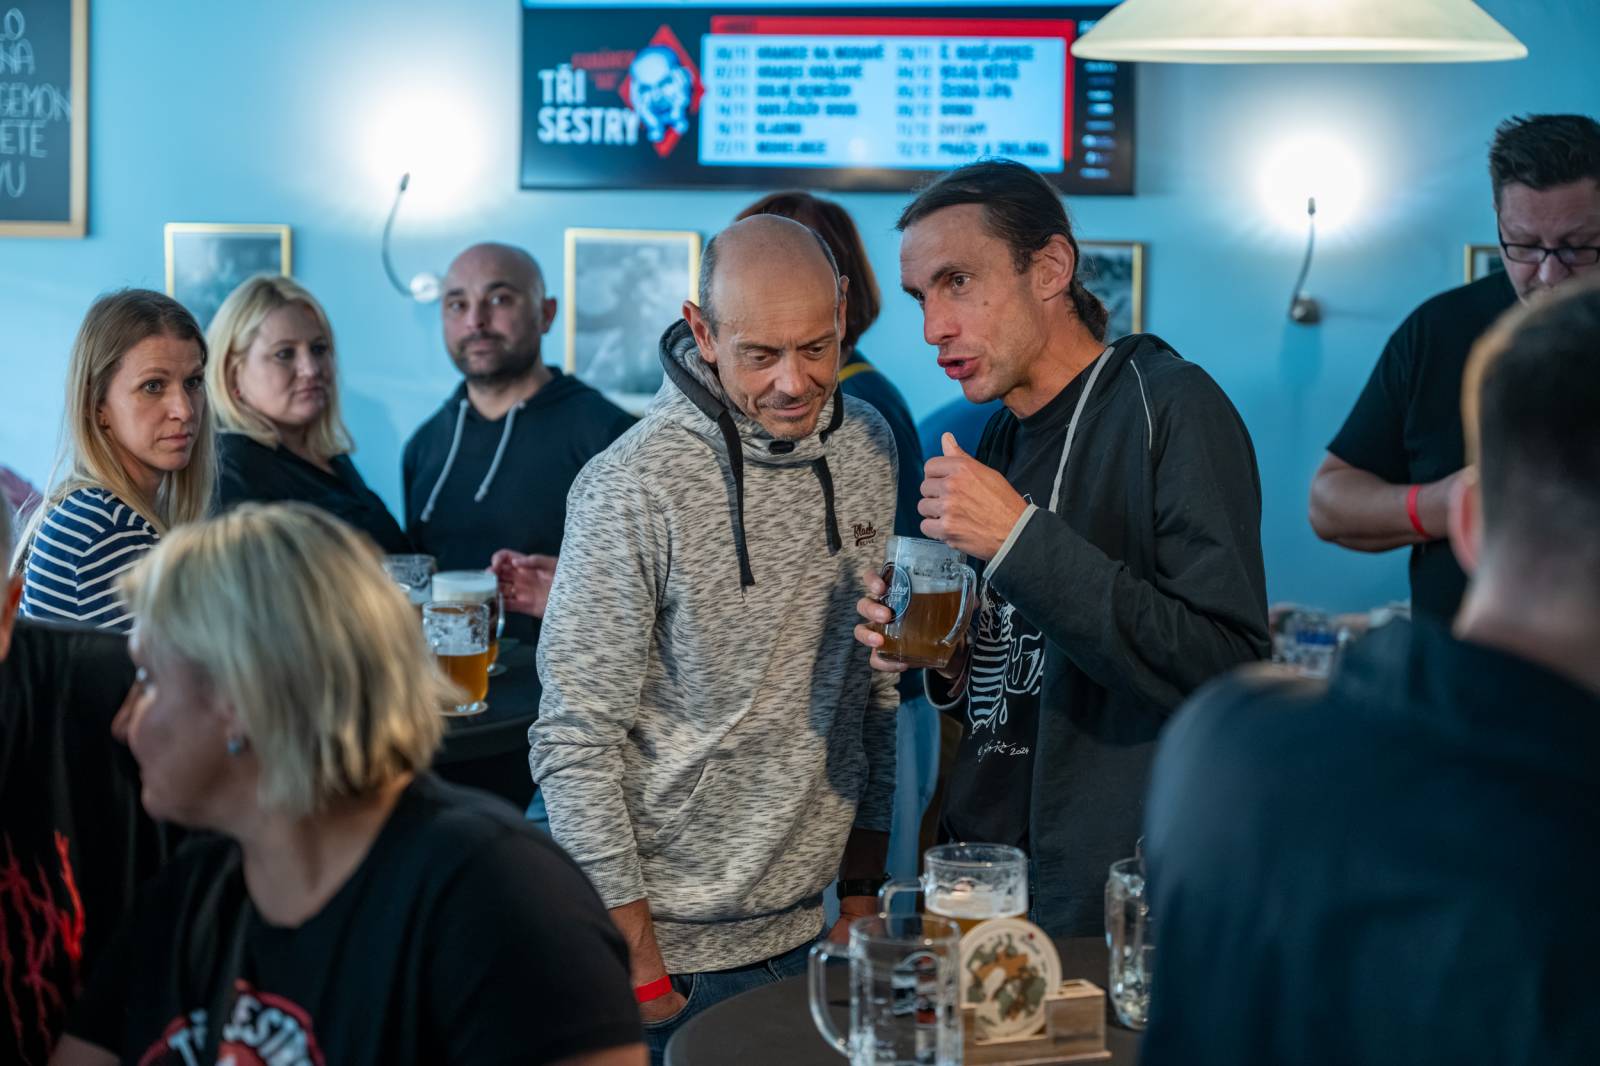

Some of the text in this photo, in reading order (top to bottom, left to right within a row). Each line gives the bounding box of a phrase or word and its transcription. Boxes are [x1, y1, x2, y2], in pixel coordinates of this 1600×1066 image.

[537, 63, 587, 105] TŘI
[537, 106, 640, 145] SESTRY
[1009, 746, 1030, 756] 2024
